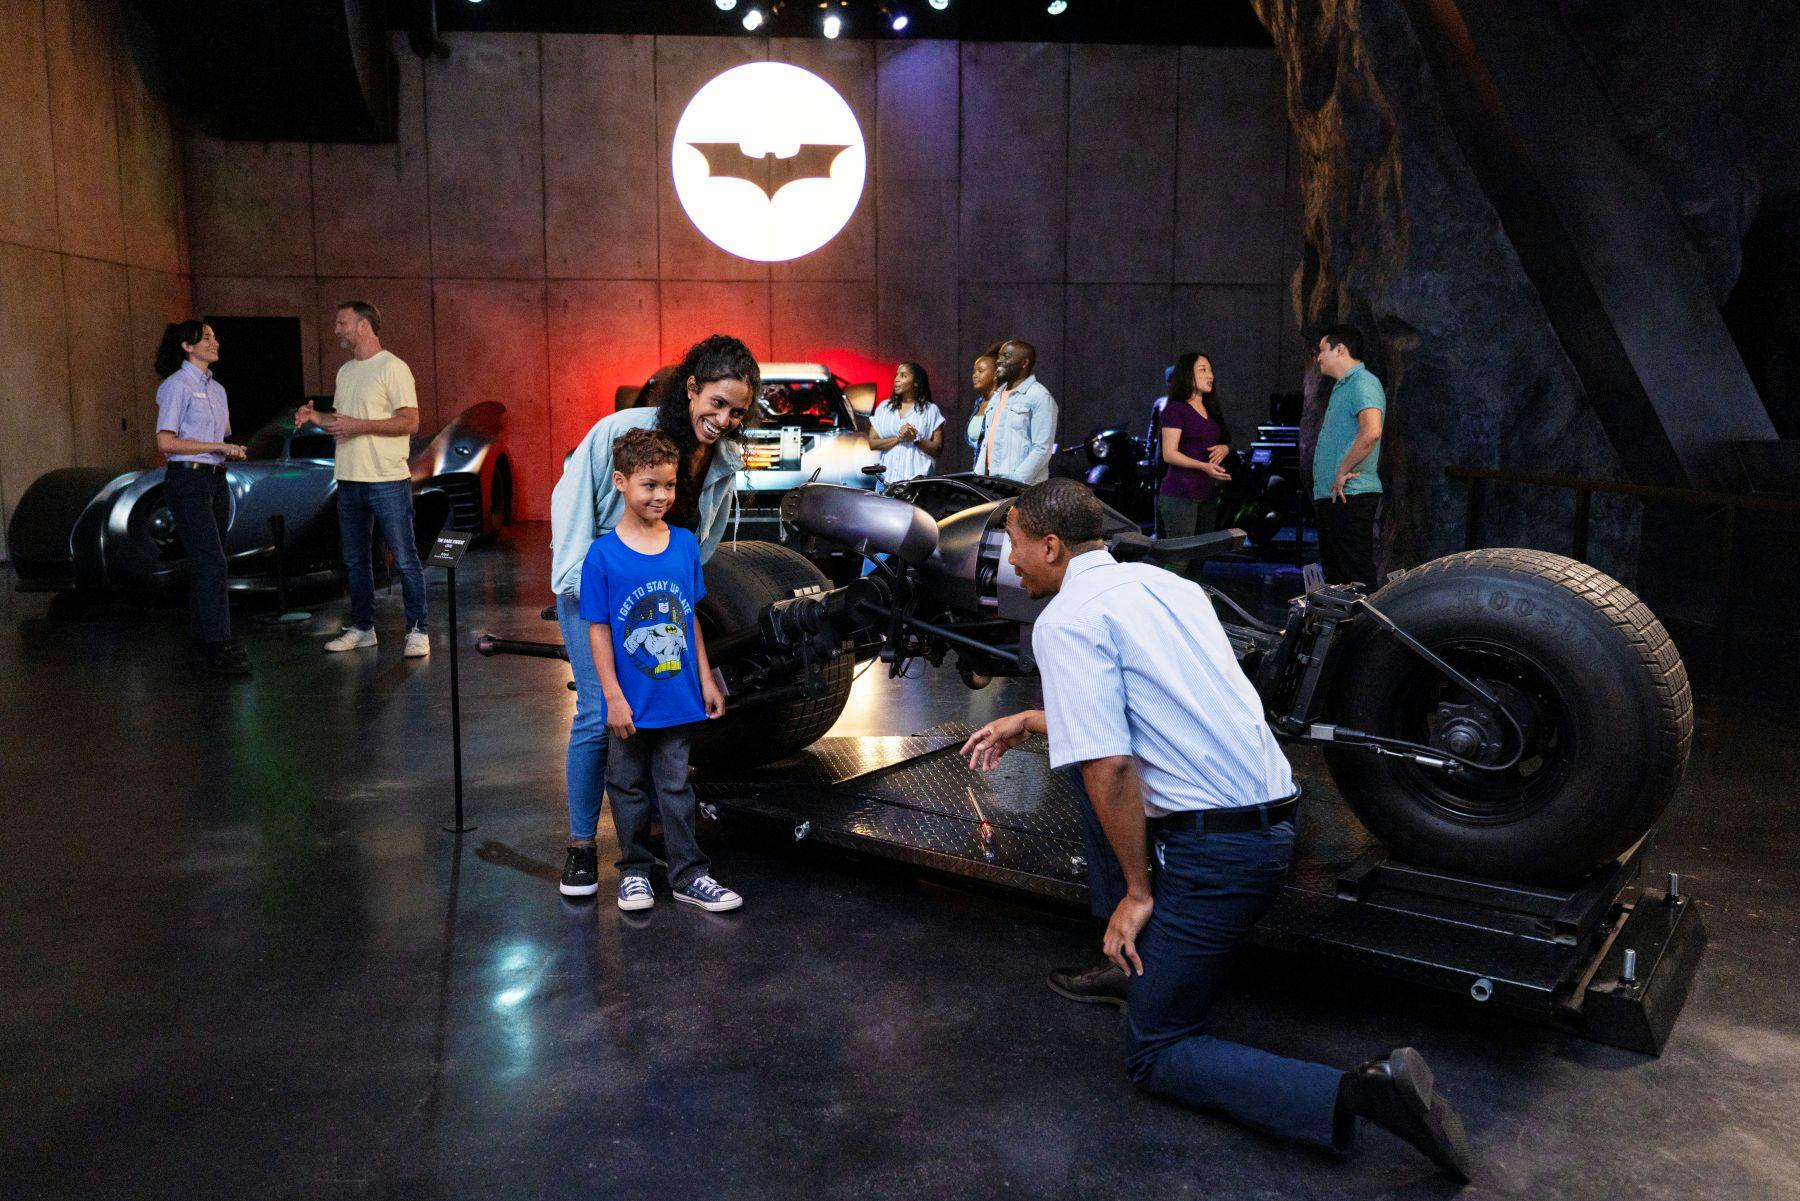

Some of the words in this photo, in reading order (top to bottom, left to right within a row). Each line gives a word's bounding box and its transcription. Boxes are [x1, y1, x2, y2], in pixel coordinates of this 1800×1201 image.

[619, 596, 634, 616] GET
[632, 586, 646, 599] TO
[646, 580, 668, 592] STAY
[670, 582, 680, 594] UP
[678, 591, 692, 615] LATE
